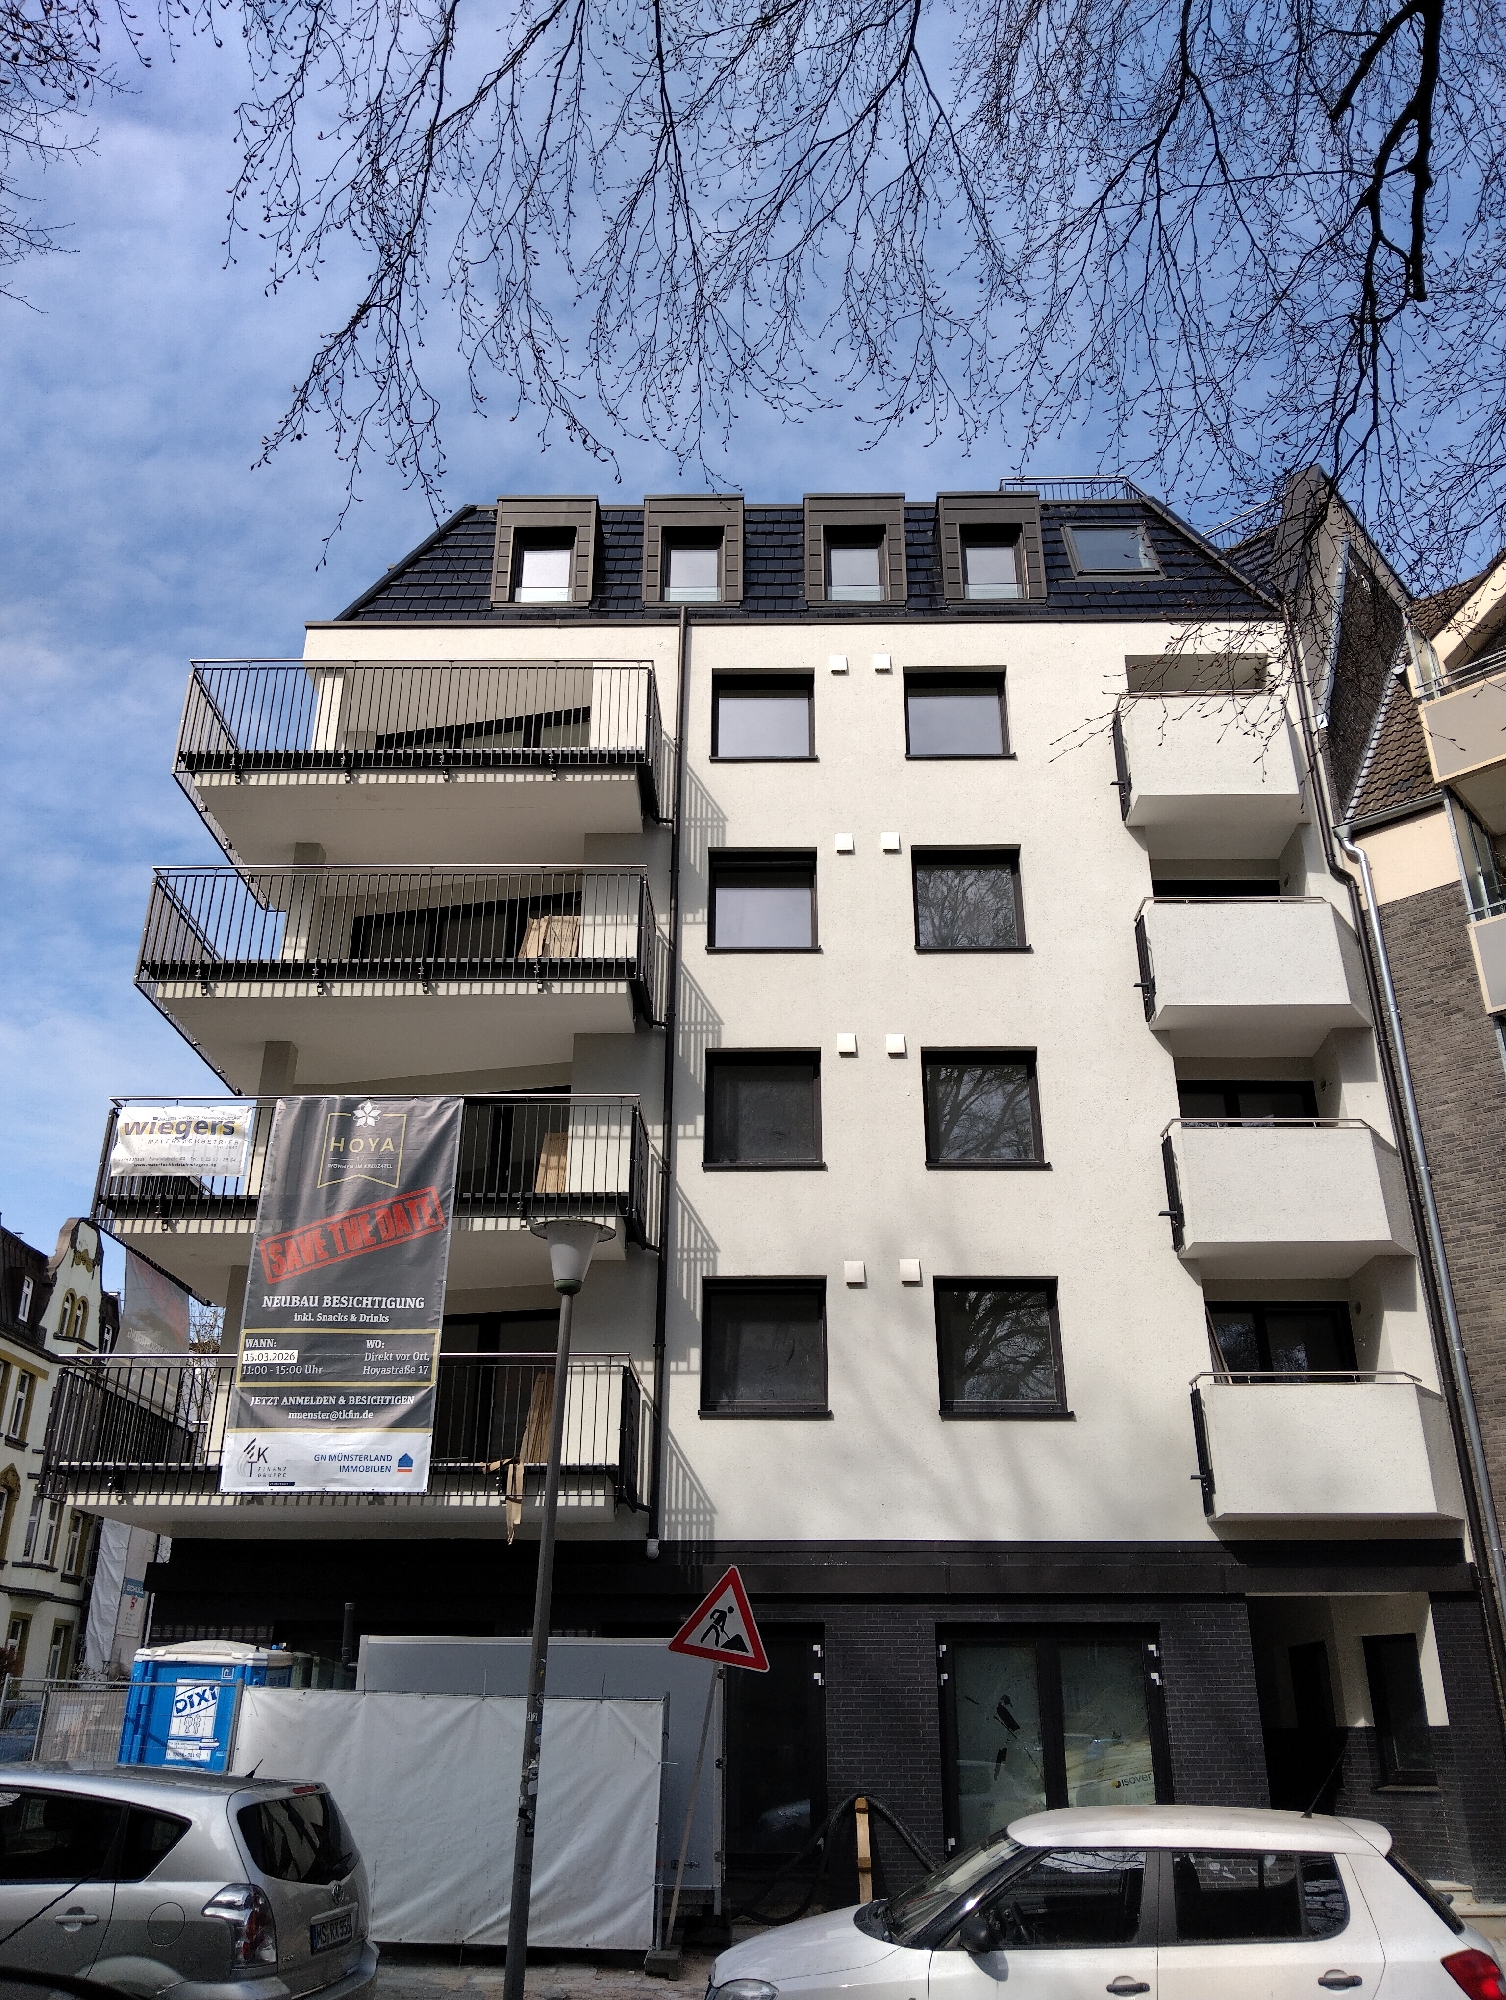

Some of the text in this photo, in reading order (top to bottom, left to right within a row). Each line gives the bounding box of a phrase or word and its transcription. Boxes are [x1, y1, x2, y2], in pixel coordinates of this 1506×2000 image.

[124, 1116, 236, 1140] wiegers
[330, 1136, 395, 1153] HOYA
[268, 1195, 437, 1276] SAVE THE DATE
[262, 1295, 425, 1310] NEUBAU BESICHTIGUNG
[294, 1312, 390, 1323] inkl. Snacks & Drinks
[245, 1338, 277, 1348] WANN:
[366, 1339, 385, 1349] WO:
[244, 1351, 296, 1362] 15.03.2026
[364, 1351, 430, 1362] Direkt vor Ort,
[242, 1365, 267, 1375] 11:00
[275, 1365, 303, 1375] 15:00
[304, 1365, 323, 1375] Uhr
[362, 1365, 429, 1377] Hoyastraße 17
[250, 1395, 415, 1406] JETZT ANMELDEN & BESICHTIGEN
[287, 1410, 374, 1421] muenster@tkfin.de
[314, 1452, 393, 1463] GN MÜNSTERLAND
[339, 1465, 392, 1473] IMMOBILIEN
